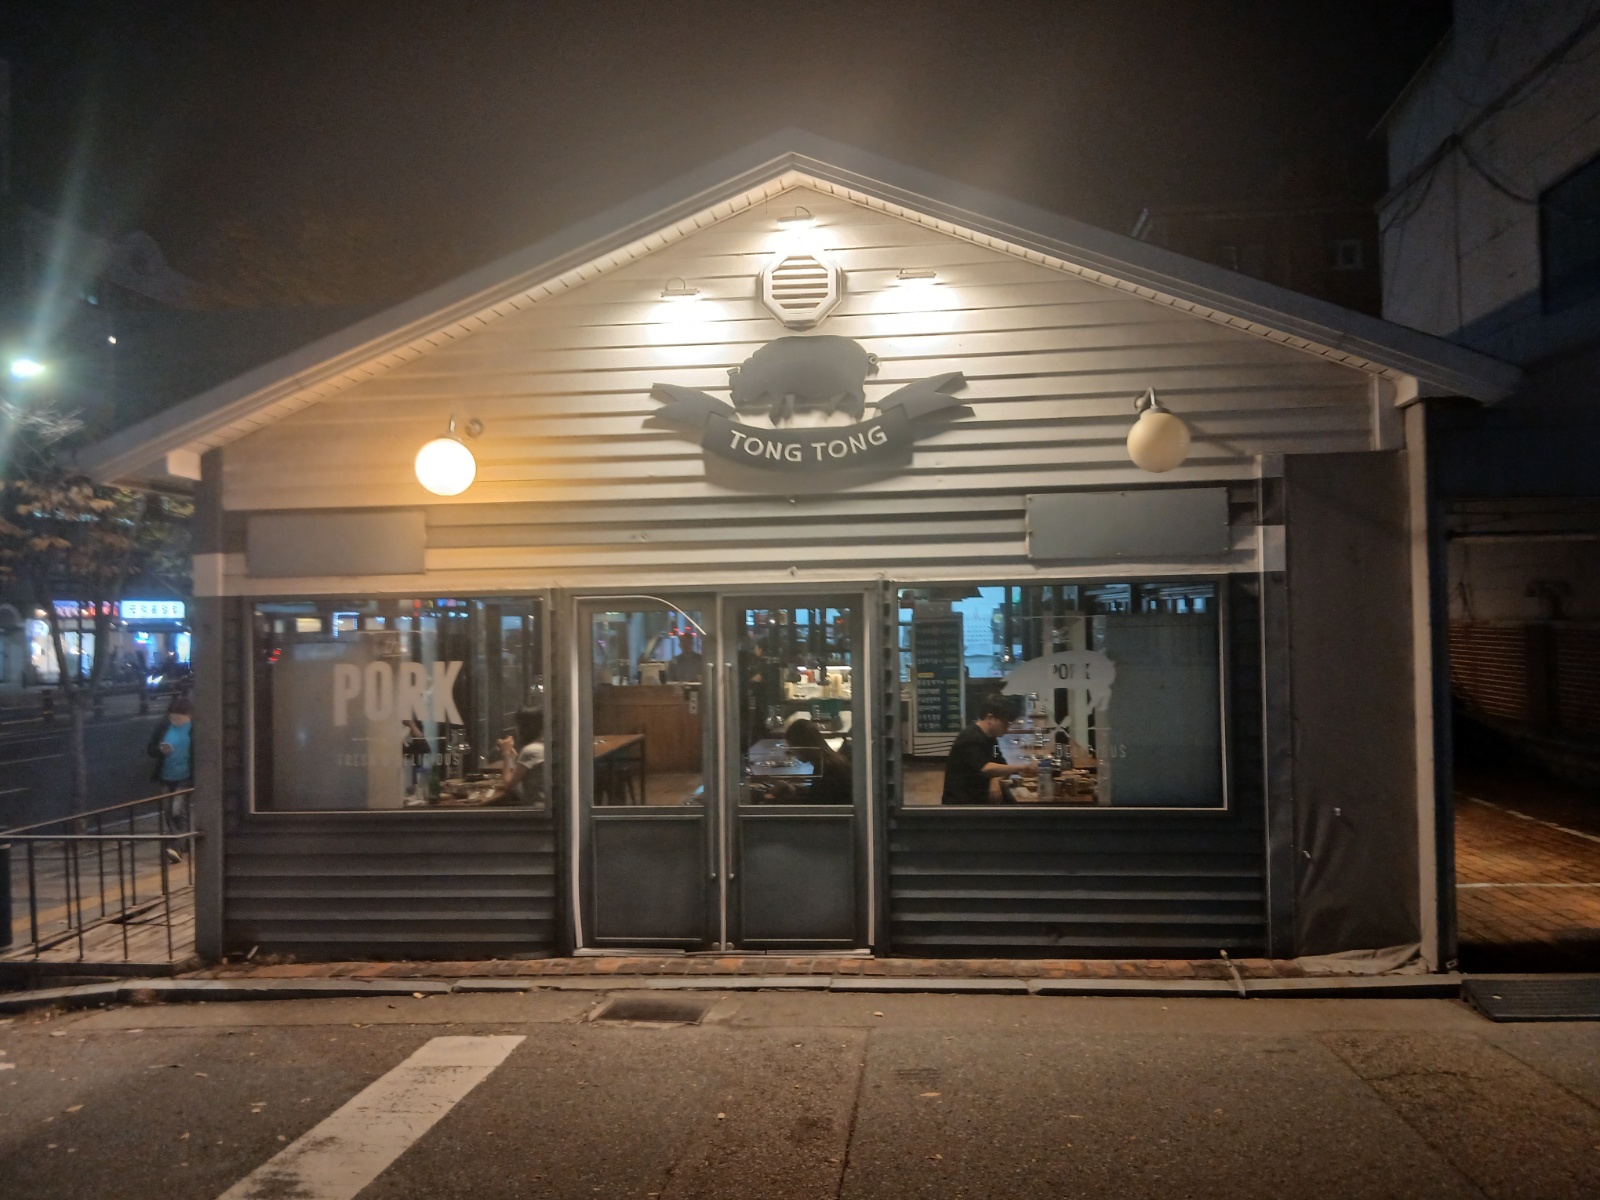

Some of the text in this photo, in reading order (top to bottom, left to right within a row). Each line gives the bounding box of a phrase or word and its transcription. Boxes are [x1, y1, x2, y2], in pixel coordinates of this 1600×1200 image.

[730, 425, 888, 462] TONG TONG
[333, 660, 464, 727] PORK
